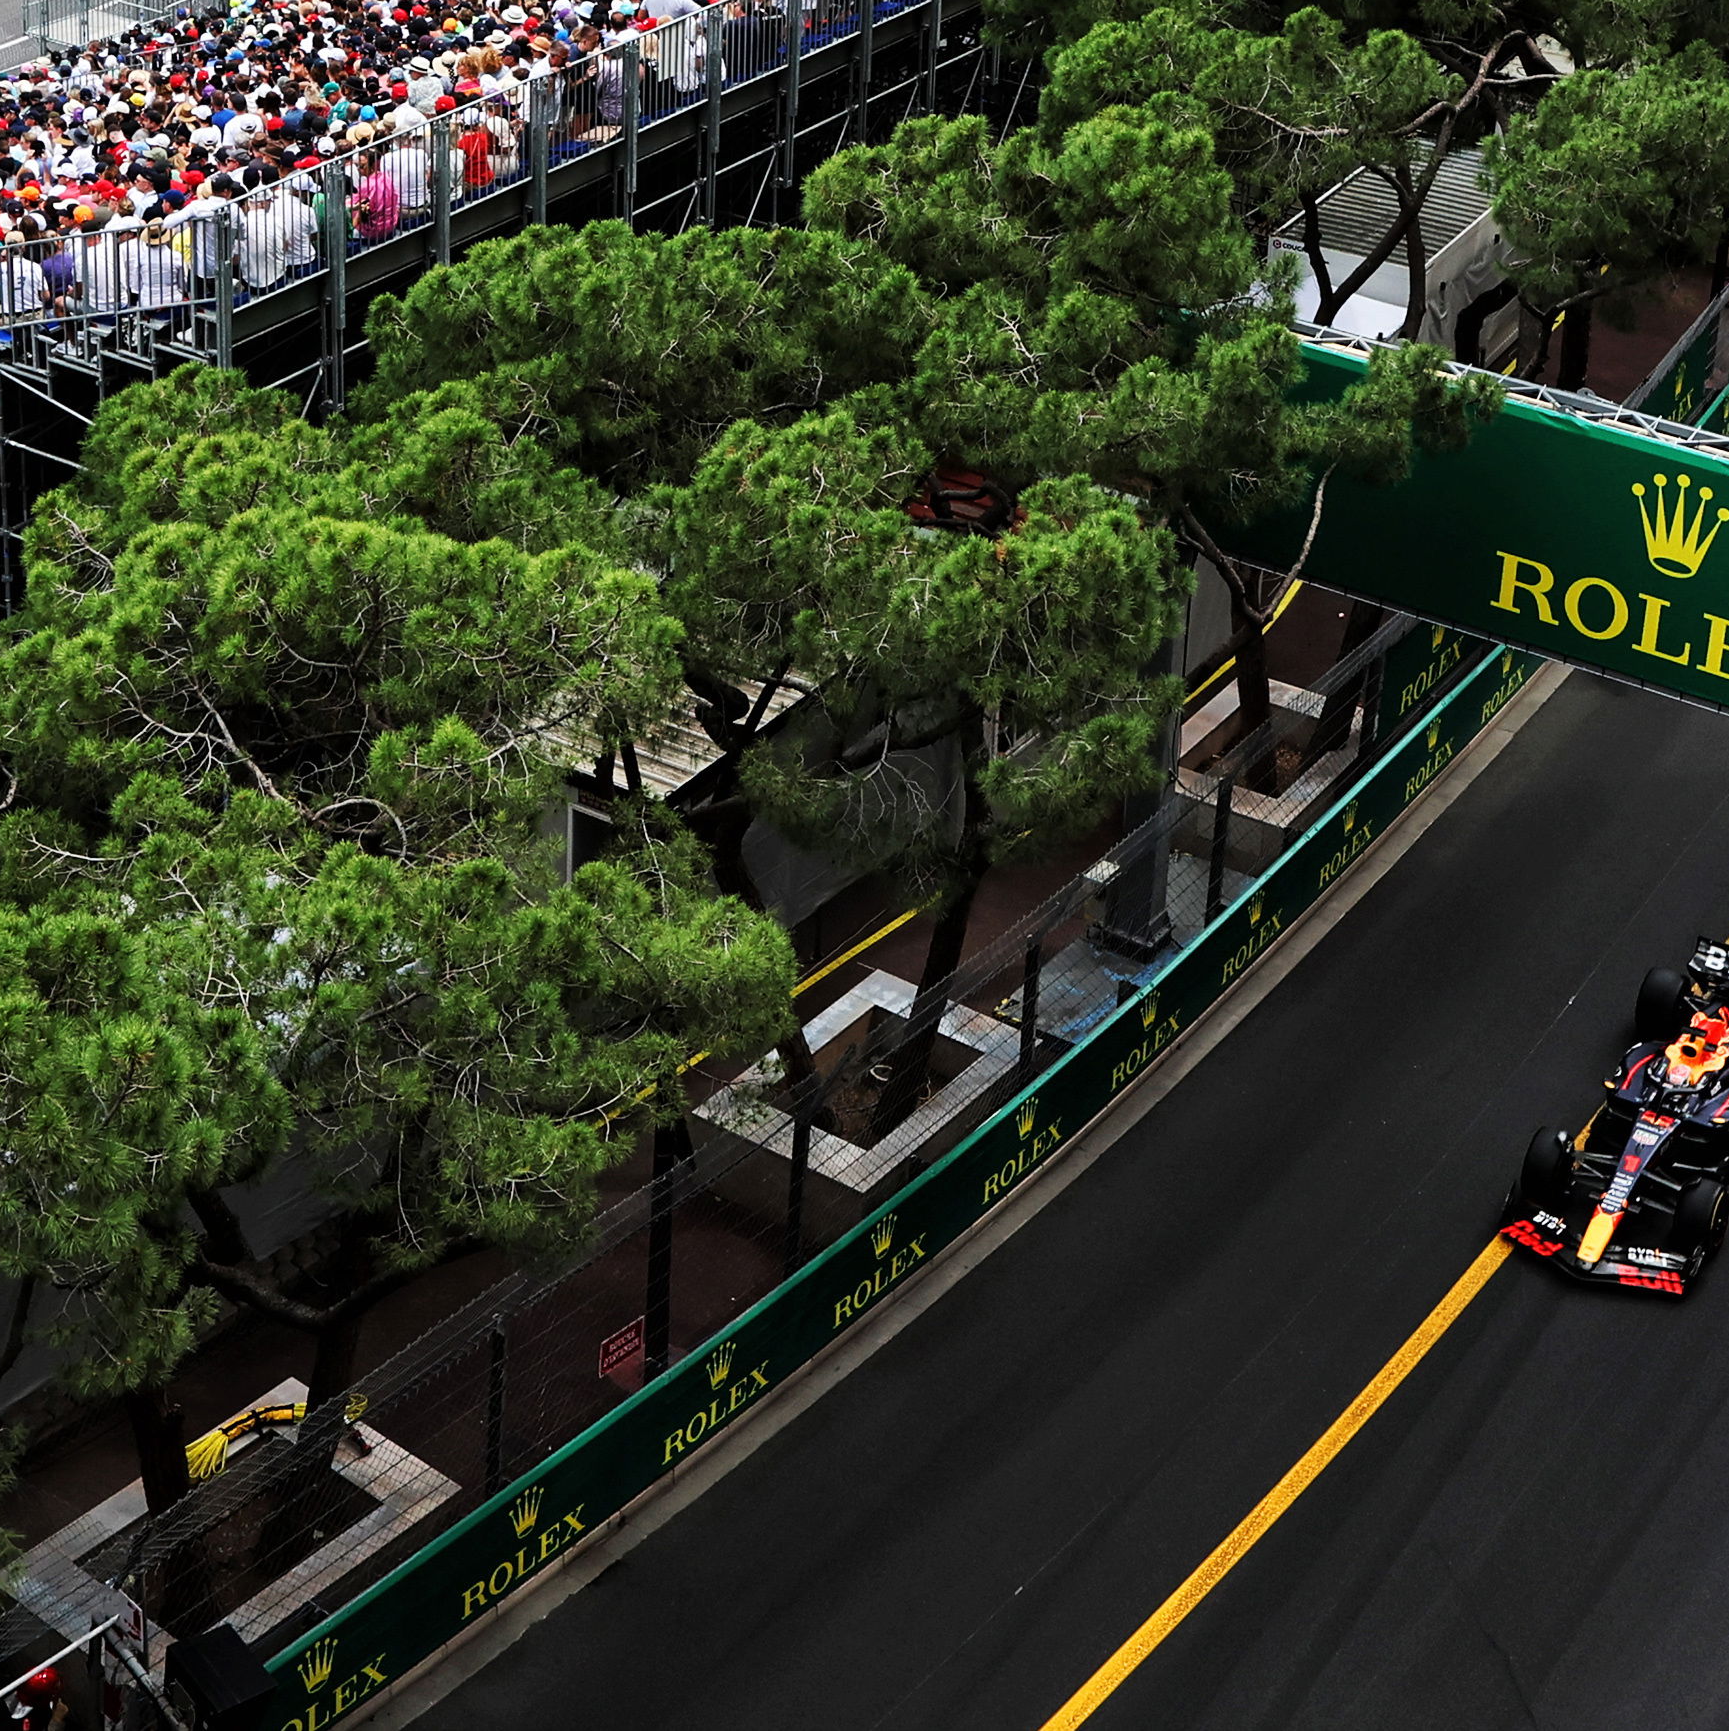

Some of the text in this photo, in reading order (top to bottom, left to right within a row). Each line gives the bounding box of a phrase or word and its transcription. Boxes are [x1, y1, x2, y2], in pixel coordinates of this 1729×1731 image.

[1399, 635, 1464, 716] ROLEX
[1480, 664, 1524, 725] ROLEX
[1404, 736, 1454, 802] ROLEX
[1318, 819, 1372, 890] ROLEX
[1220, 909, 1283, 986] ROLEX
[1110, 1008, 1182, 1093] ROLEX
[982, 1118, 1062, 1205] ROLEX
[1500, 1220, 1565, 1256] Red
[832, 1234, 929, 1329] ROLEX
[1617, 1264, 1684, 1295] Bull
[661, 1361, 771, 1466] ROLEX
[460, 1503, 587, 1621] ROLEX
